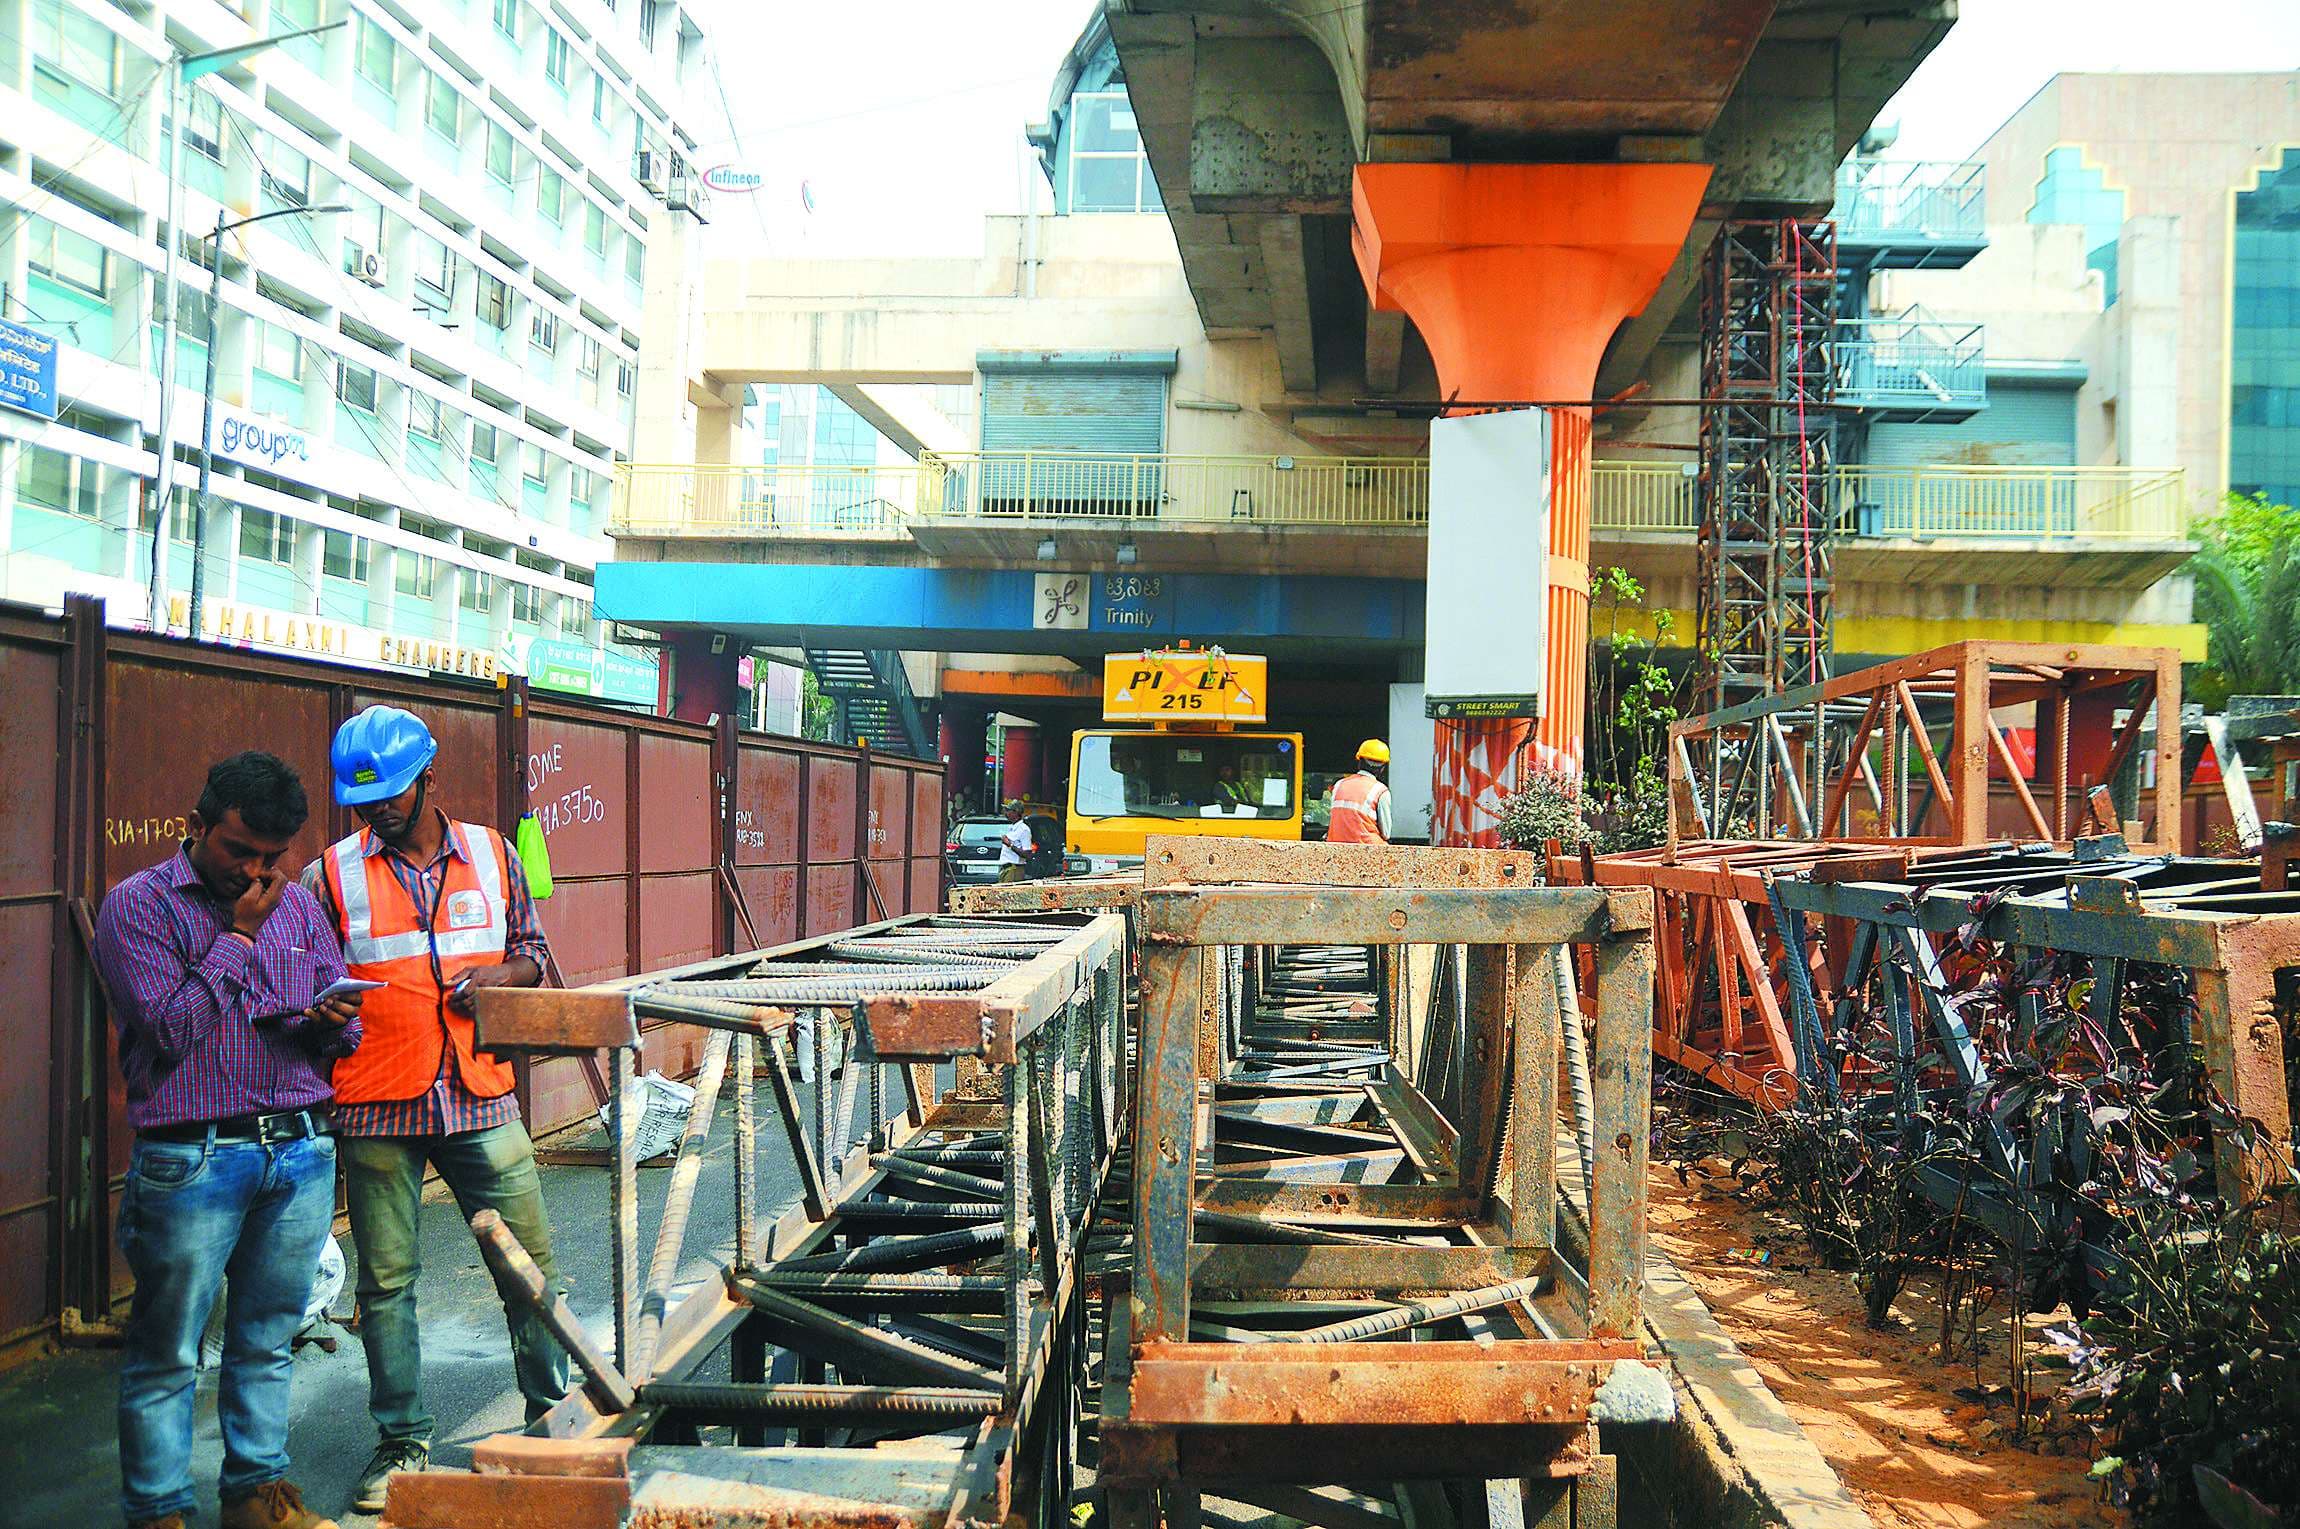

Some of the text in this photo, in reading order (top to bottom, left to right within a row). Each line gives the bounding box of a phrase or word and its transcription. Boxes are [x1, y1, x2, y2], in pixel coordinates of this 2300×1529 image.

[1105, 607, 1153, 627] Trinity
[380, 636, 496, 678] CHAMBERS
[1160, 694, 1202, 709] 215
[1456, 702, 1520, 711] STREET SMART
[527, 744, 562, 792] SME
